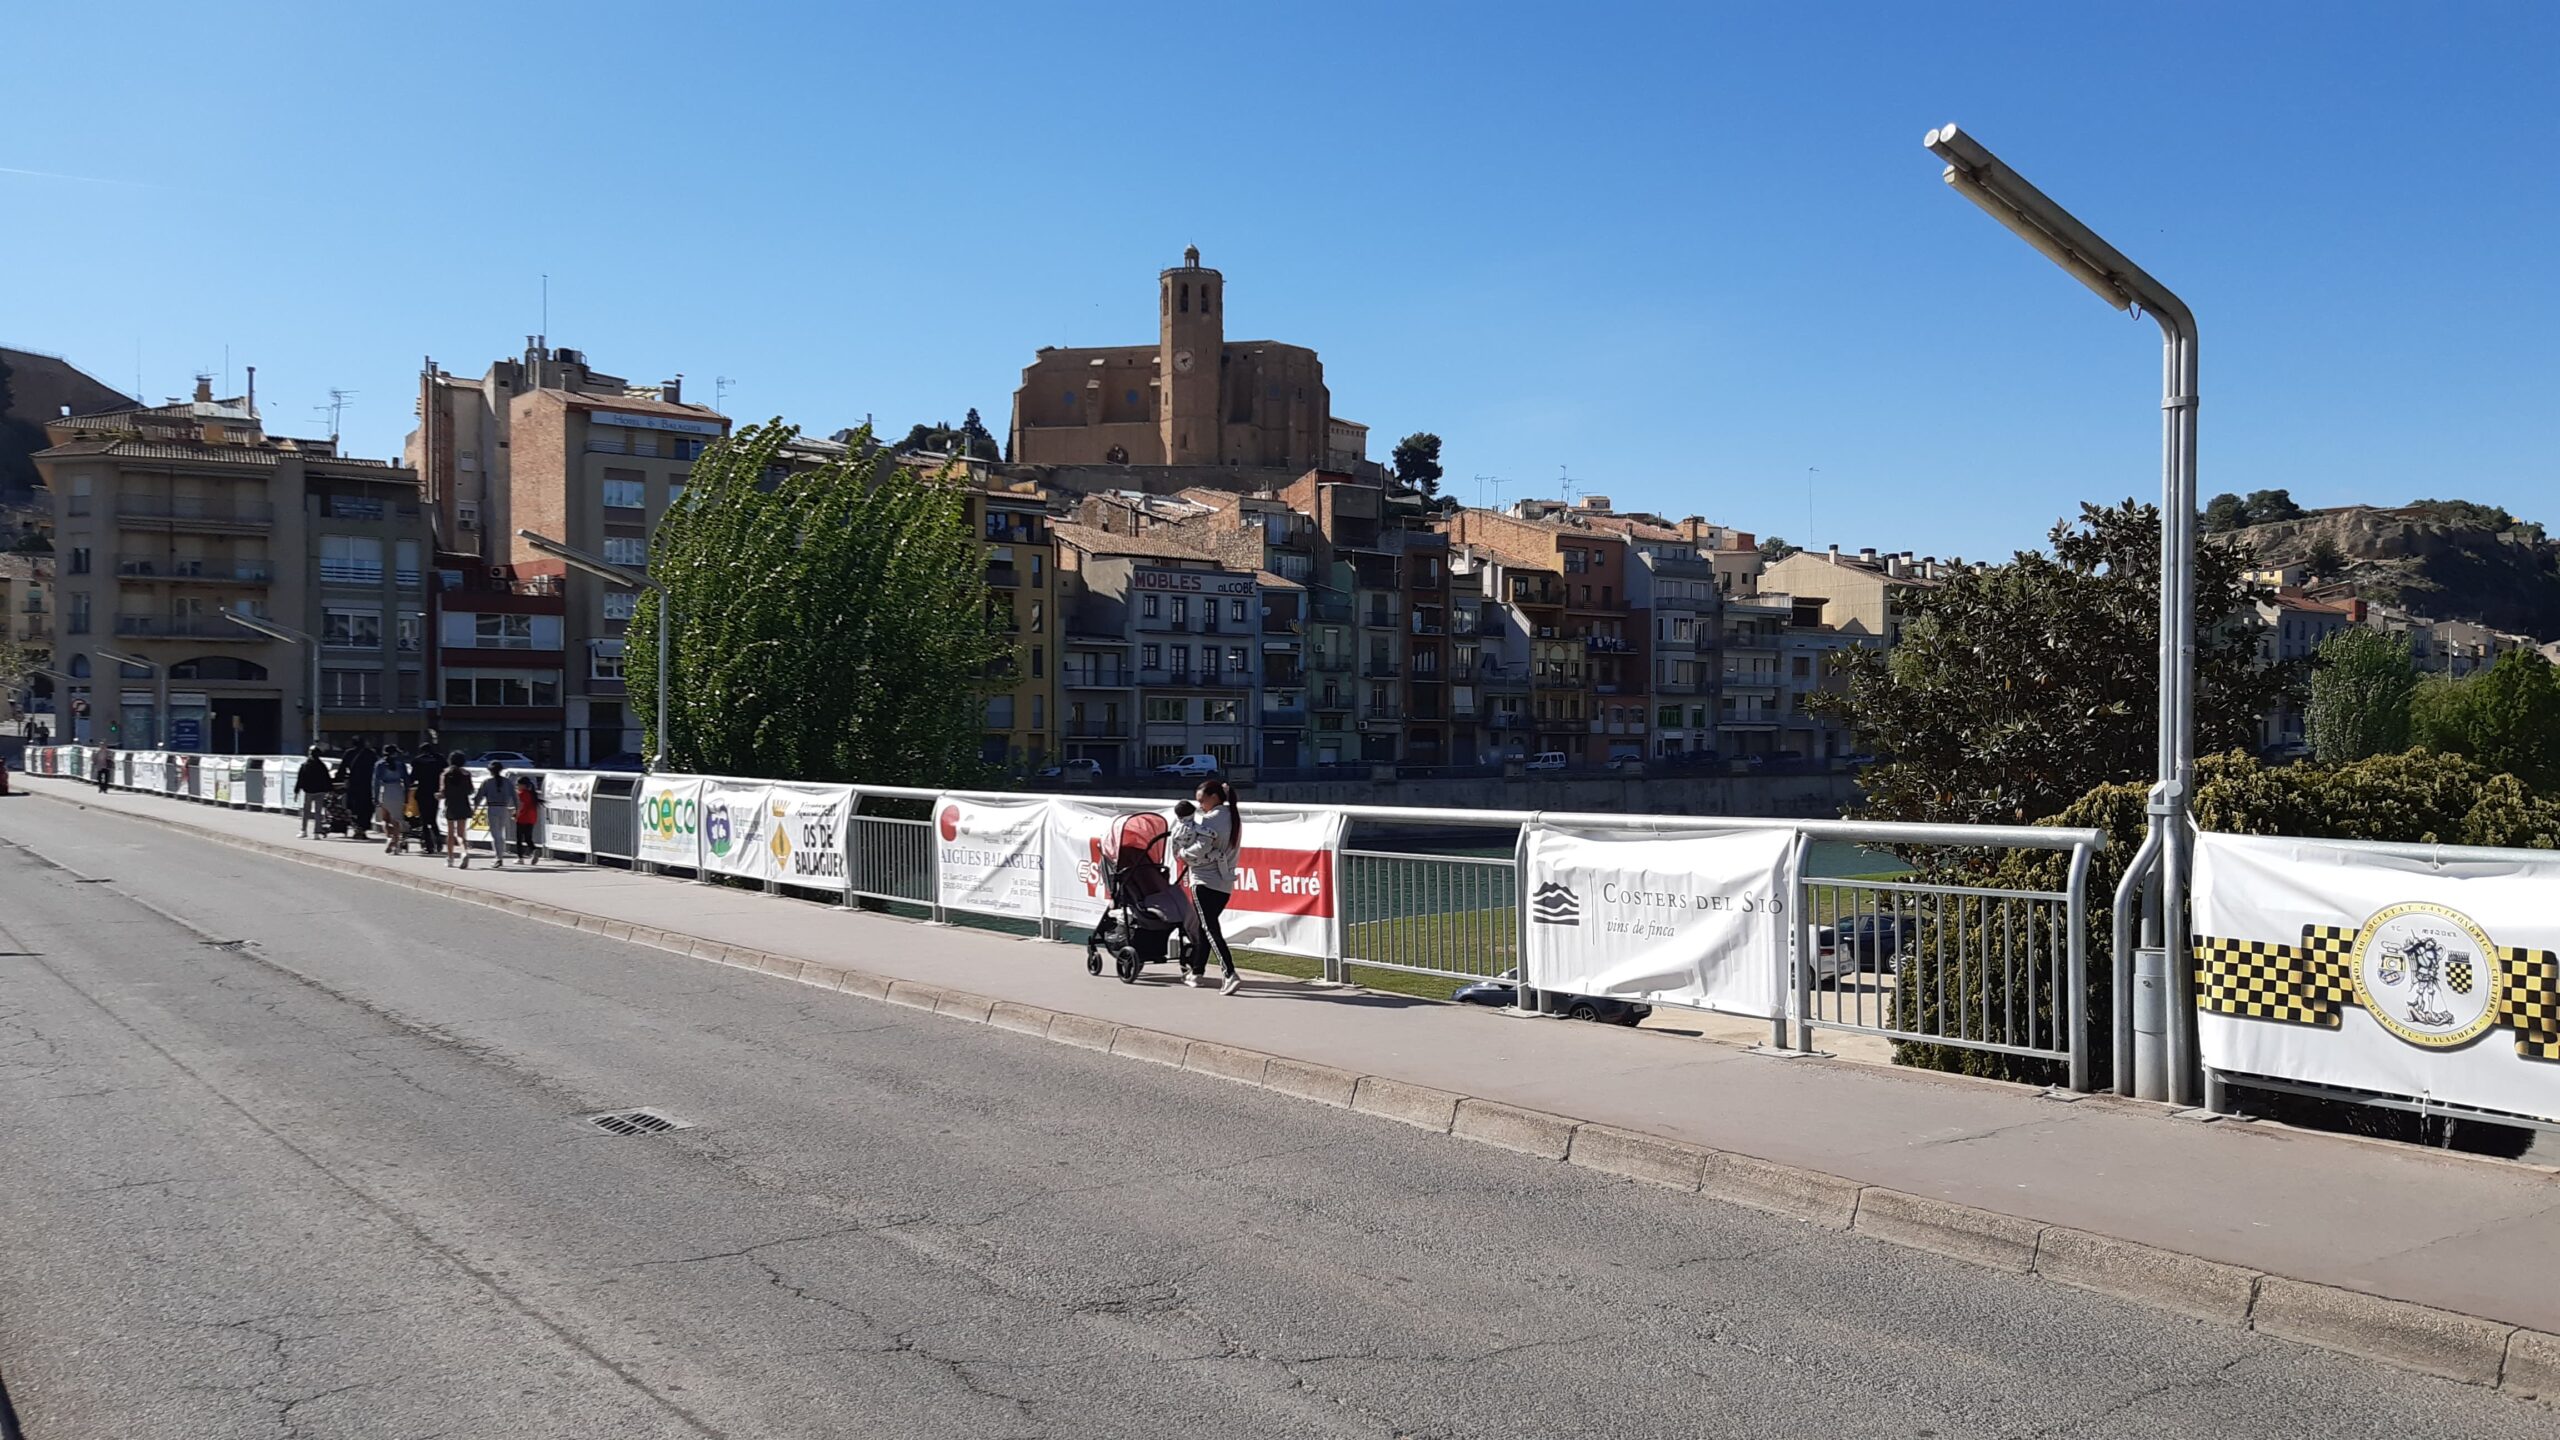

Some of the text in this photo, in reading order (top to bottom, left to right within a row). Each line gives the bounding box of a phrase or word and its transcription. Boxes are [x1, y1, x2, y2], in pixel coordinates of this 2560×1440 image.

[1134, 572, 1202, 590] MOBLES
[803, 823, 834, 848] OS DE
[795, 851, 844, 878] BALAGUER
[940, 846, 1044, 870] AIGÜES BALAGUER
[1269, 869, 1321, 896] Farré
[1603, 882, 1687, 909] COSTERS
[1607, 918, 1675, 940] vins de finca
